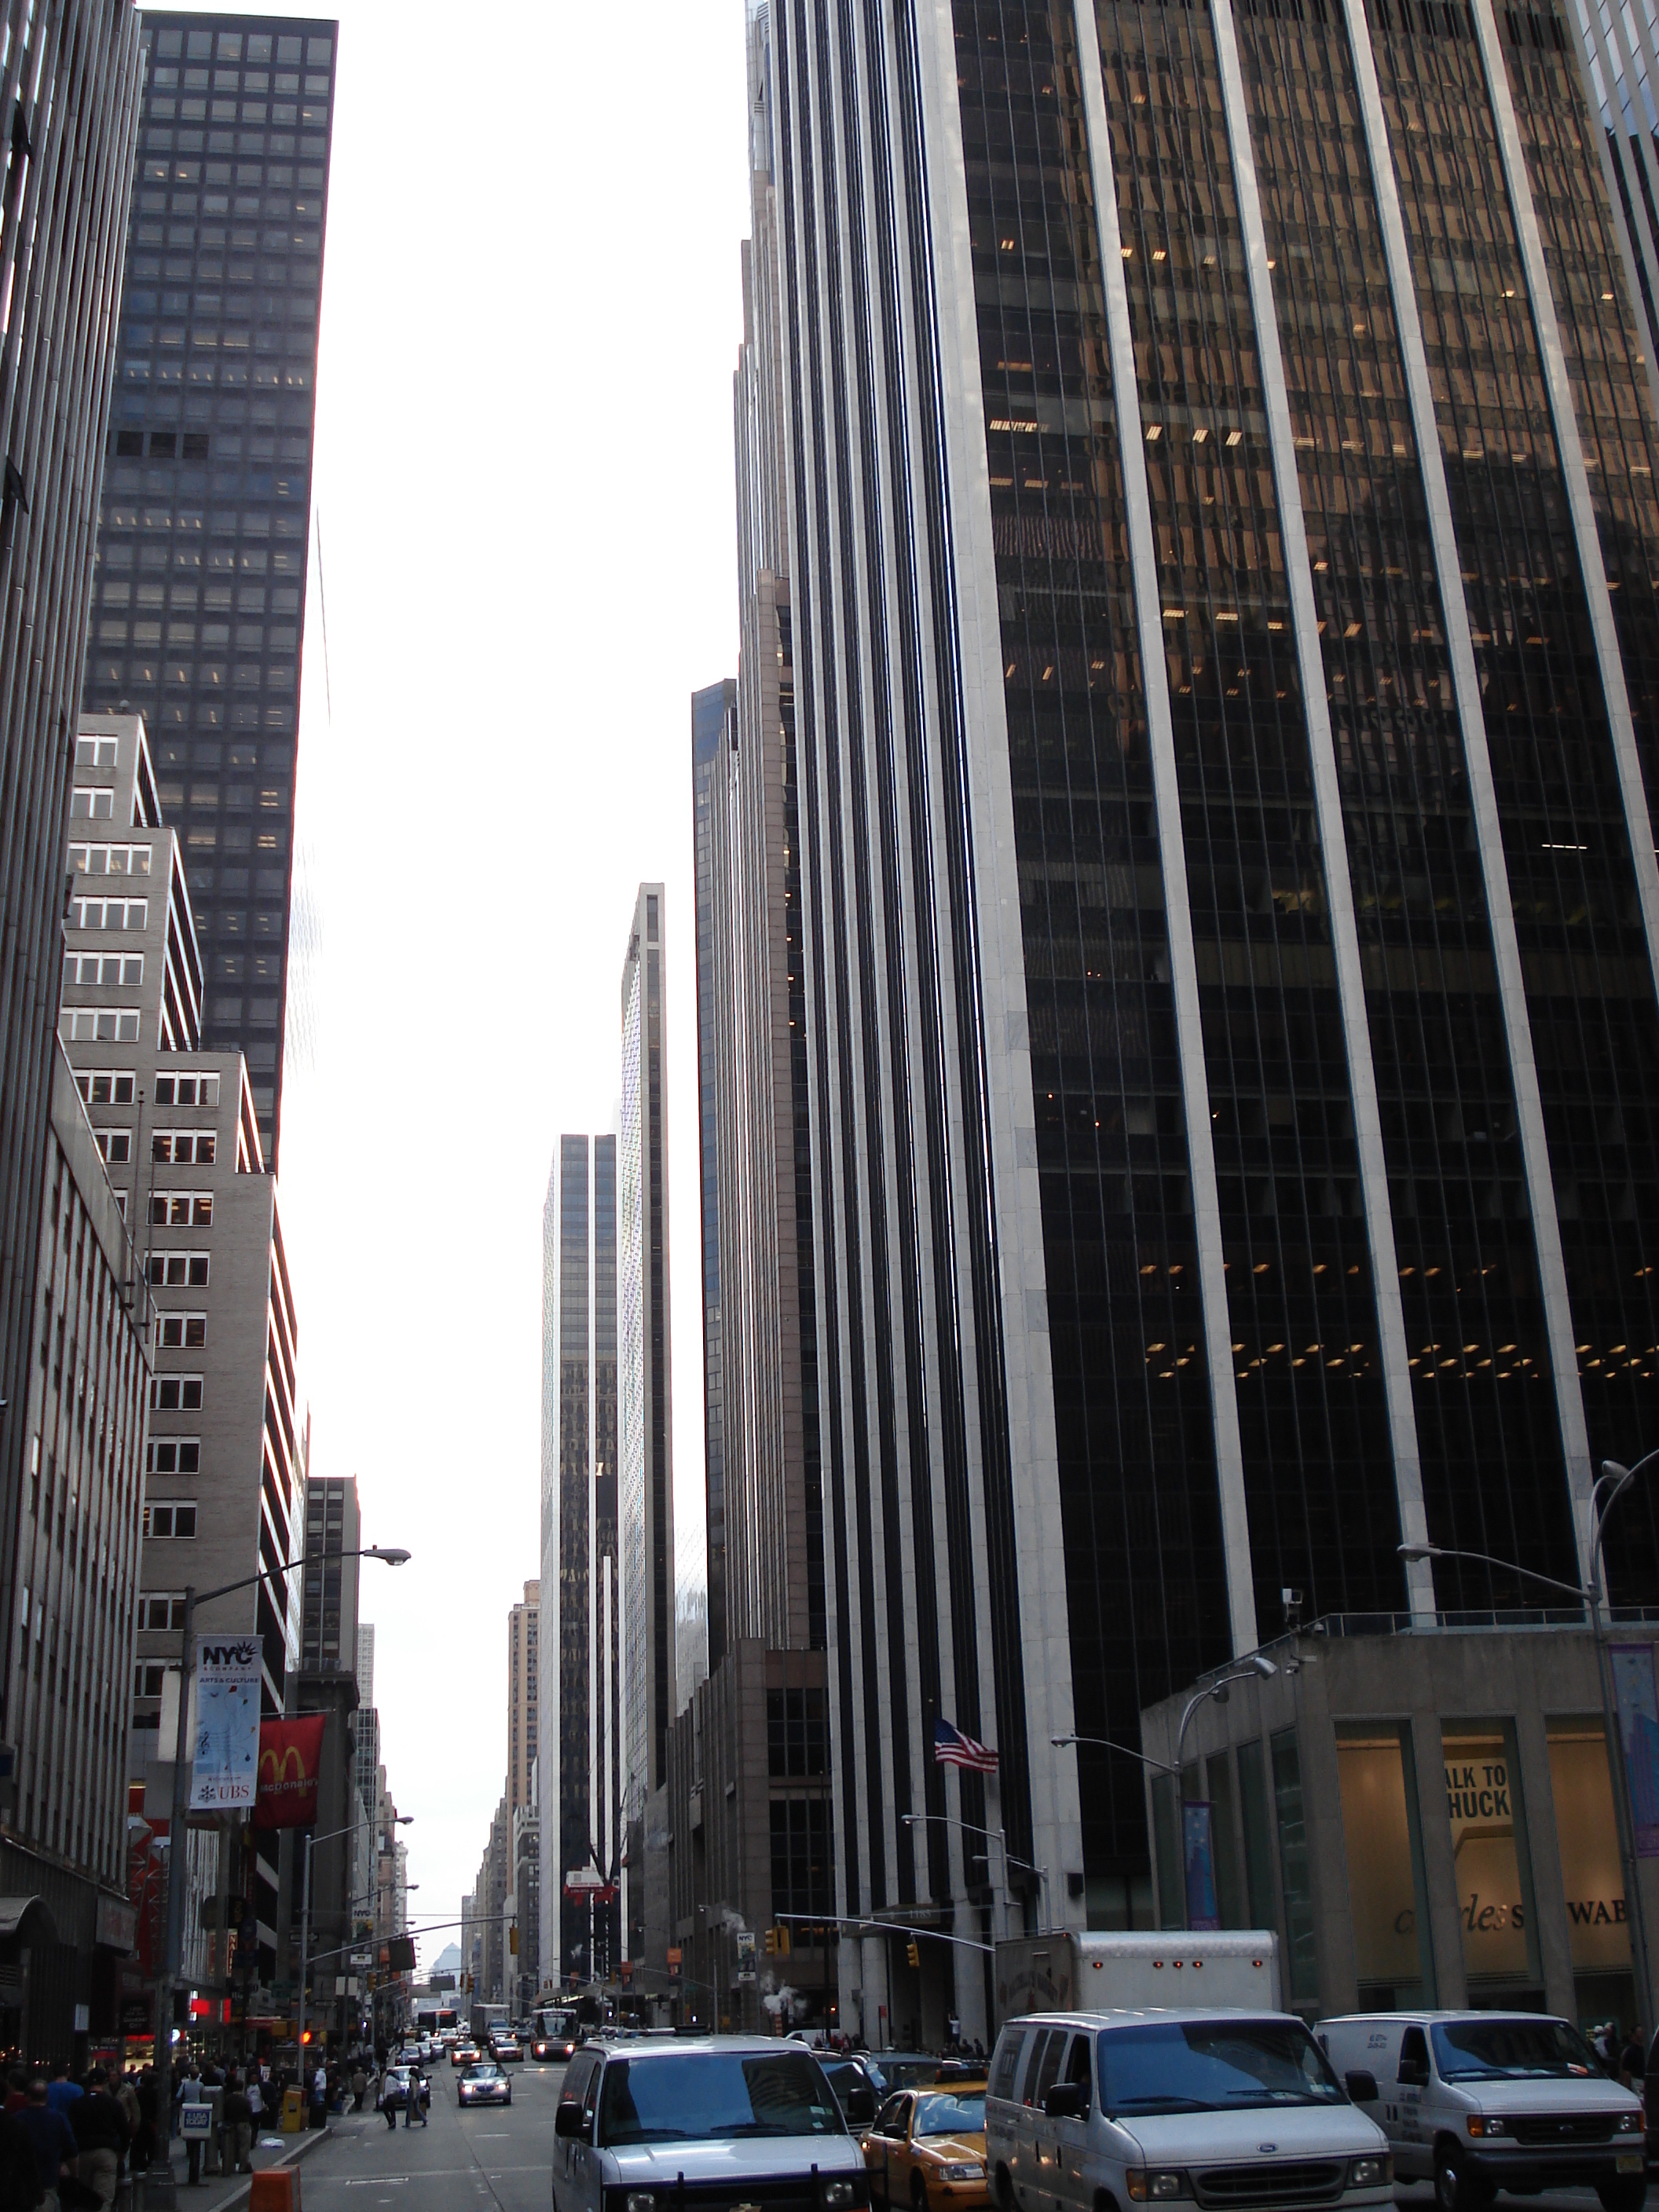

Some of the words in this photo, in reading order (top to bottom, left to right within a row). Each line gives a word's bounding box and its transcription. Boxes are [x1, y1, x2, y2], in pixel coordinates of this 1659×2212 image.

[203, 1642, 258, 1664] NYC
[1482, 1764, 1507, 1787] TO
[220, 1785, 250, 1800] UBS
[1447, 1789, 1511, 1818] HUCK
